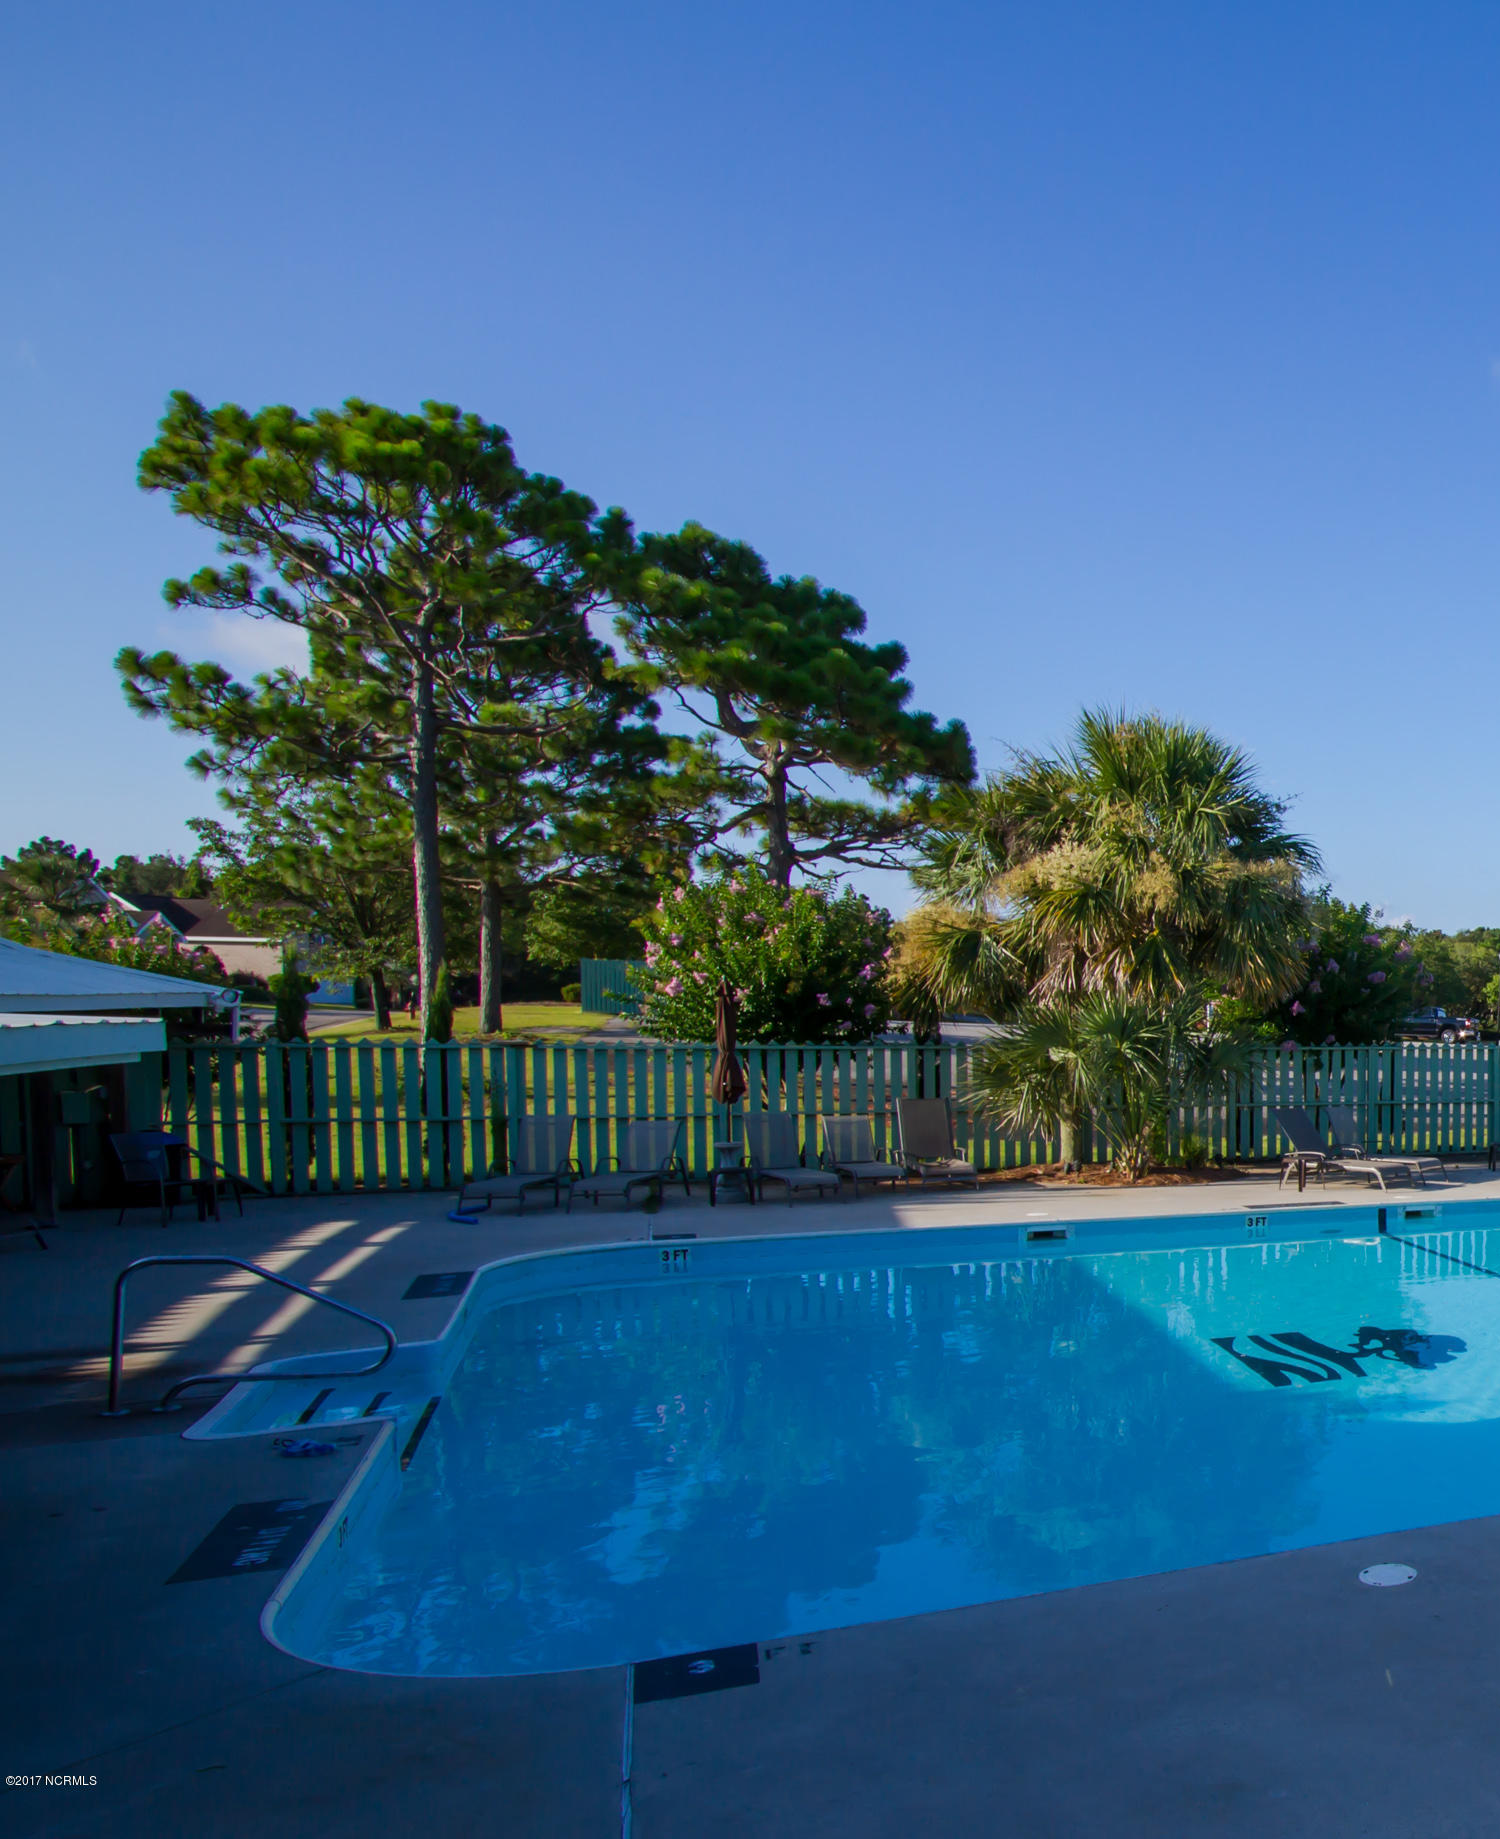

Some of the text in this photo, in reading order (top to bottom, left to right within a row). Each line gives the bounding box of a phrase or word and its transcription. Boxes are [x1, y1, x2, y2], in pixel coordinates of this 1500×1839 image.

[1247, 1216, 1267, 1227] 3 FT
[662, 1249, 689, 1261] 3 FT
